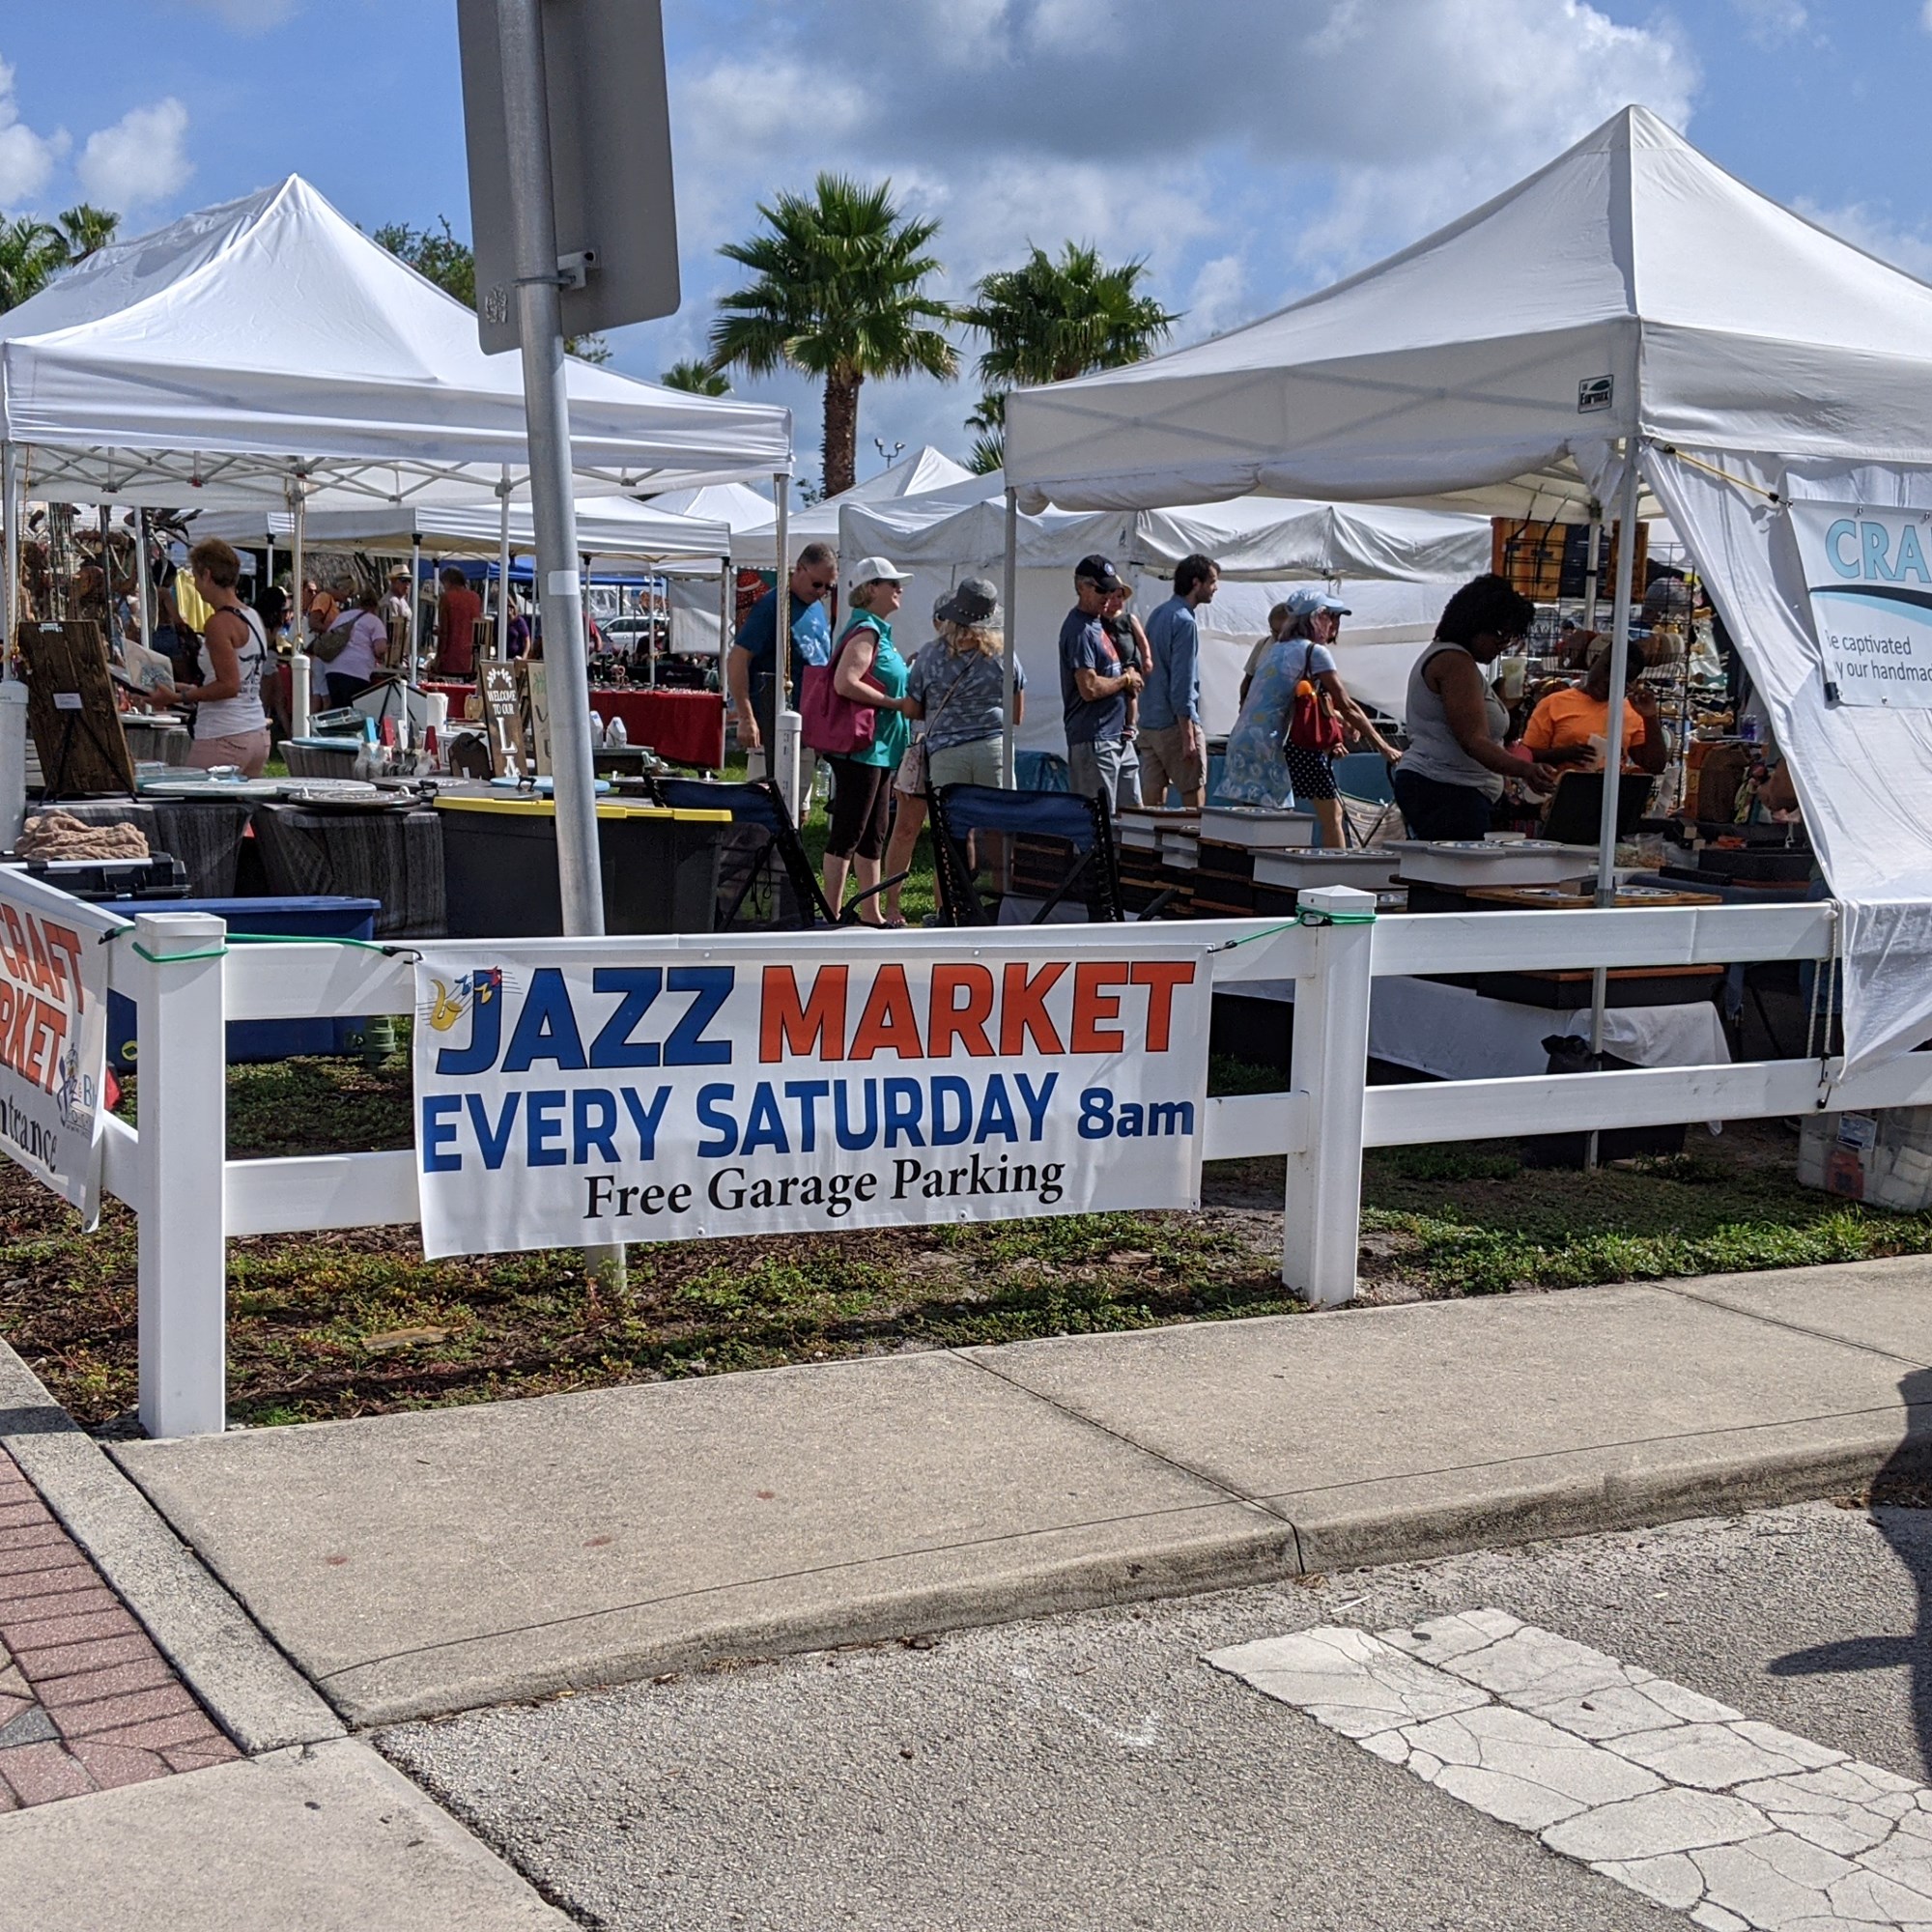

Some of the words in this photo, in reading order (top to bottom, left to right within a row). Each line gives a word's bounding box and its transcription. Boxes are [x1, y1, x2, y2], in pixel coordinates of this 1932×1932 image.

[1826, 519, 1932, 583] CRA
[1842, 635, 1912, 656] captivated
[1847, 663, 1867, 678] our
[487, 690, 517, 701] WELCOME
[493, 703, 501, 715] TO
[502, 704, 515, 715] OUR
[436, 966, 735, 1075] JAZZ
[758, 961, 1197, 1064] MARKET
[422, 1085, 673, 1174] EVERY
[696, 1071, 1059, 1158] SATURDAY
[1077, 1087, 1195, 1140] 8am
[582, 1174, 693, 1219] Free
[708, 1167, 877, 1218] Garage
[890, 1152, 1065, 1205] Parking
